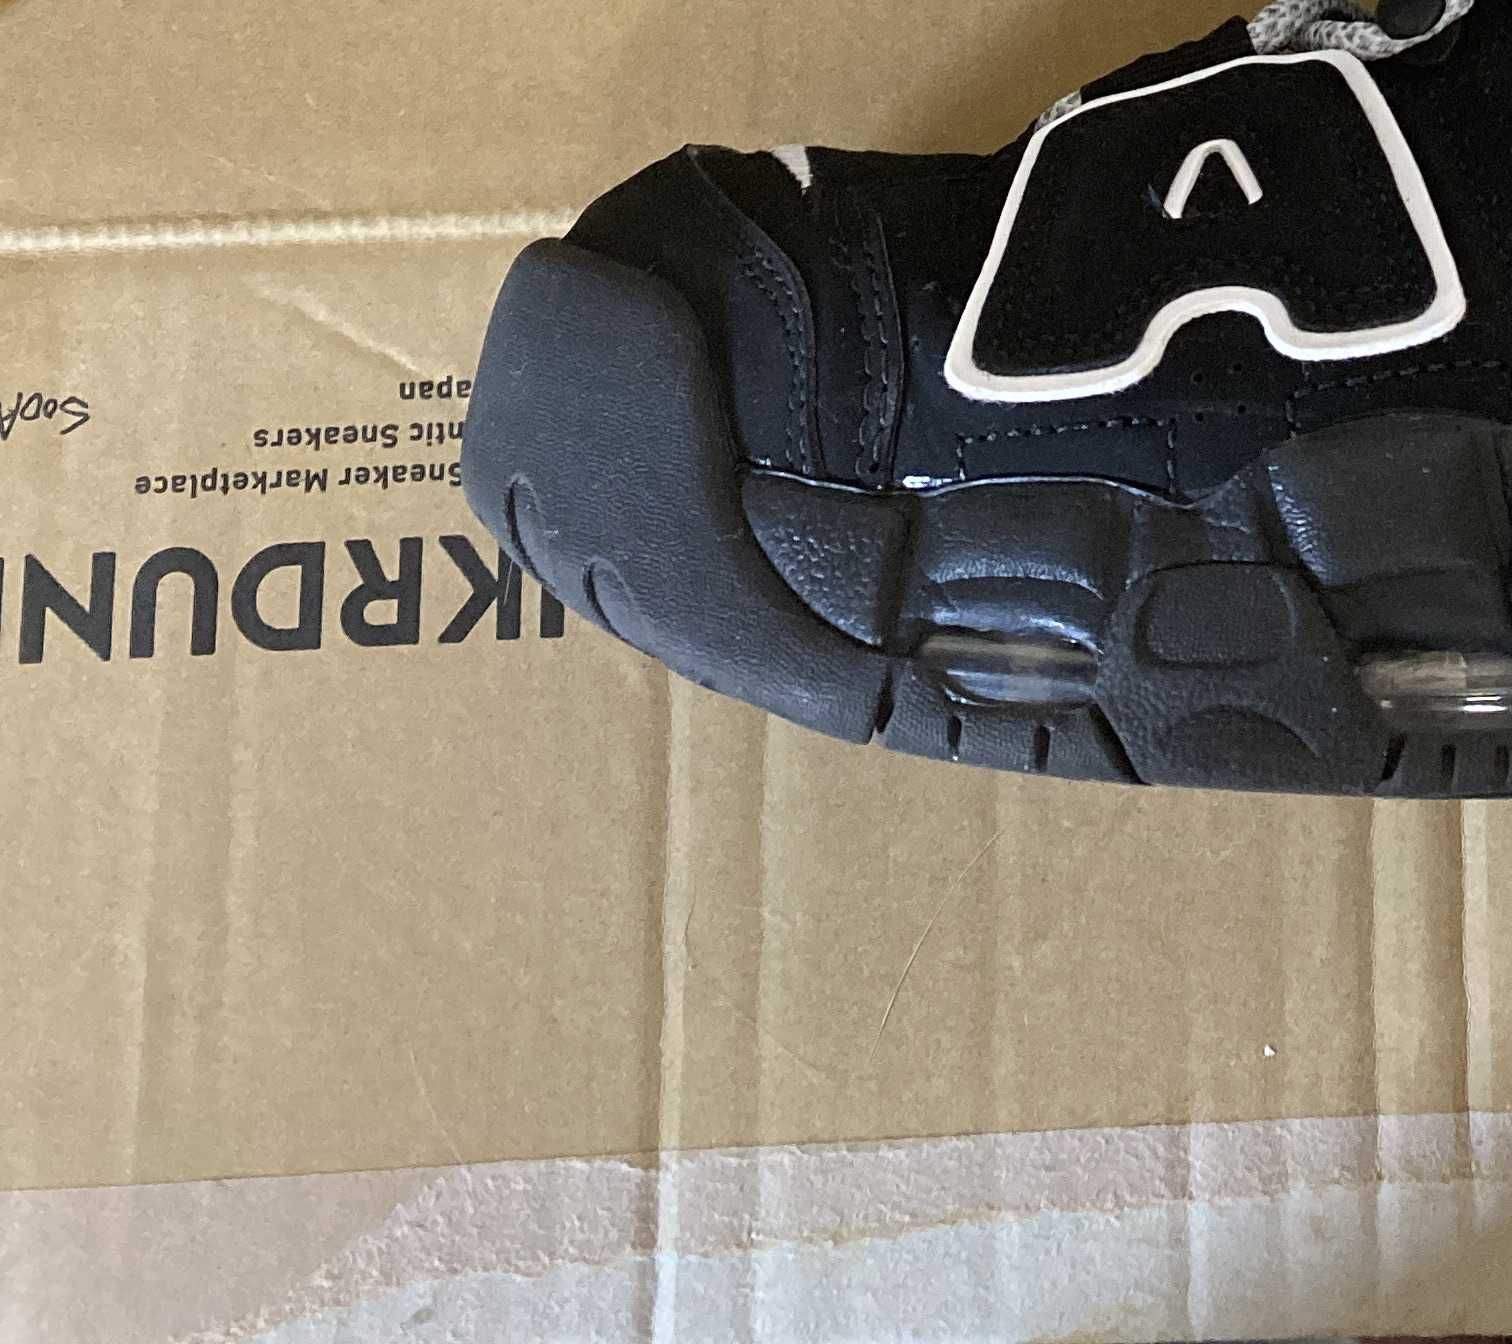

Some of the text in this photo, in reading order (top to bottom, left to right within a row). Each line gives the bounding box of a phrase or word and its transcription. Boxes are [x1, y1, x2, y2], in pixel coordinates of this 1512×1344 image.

[400, 377, 472, 403] apan
[253, 420, 465, 449] ntic Sneakers
[134, 461, 463, 499] Sneaker Marketplace
[0, 533, 565, 664] KRDUN
